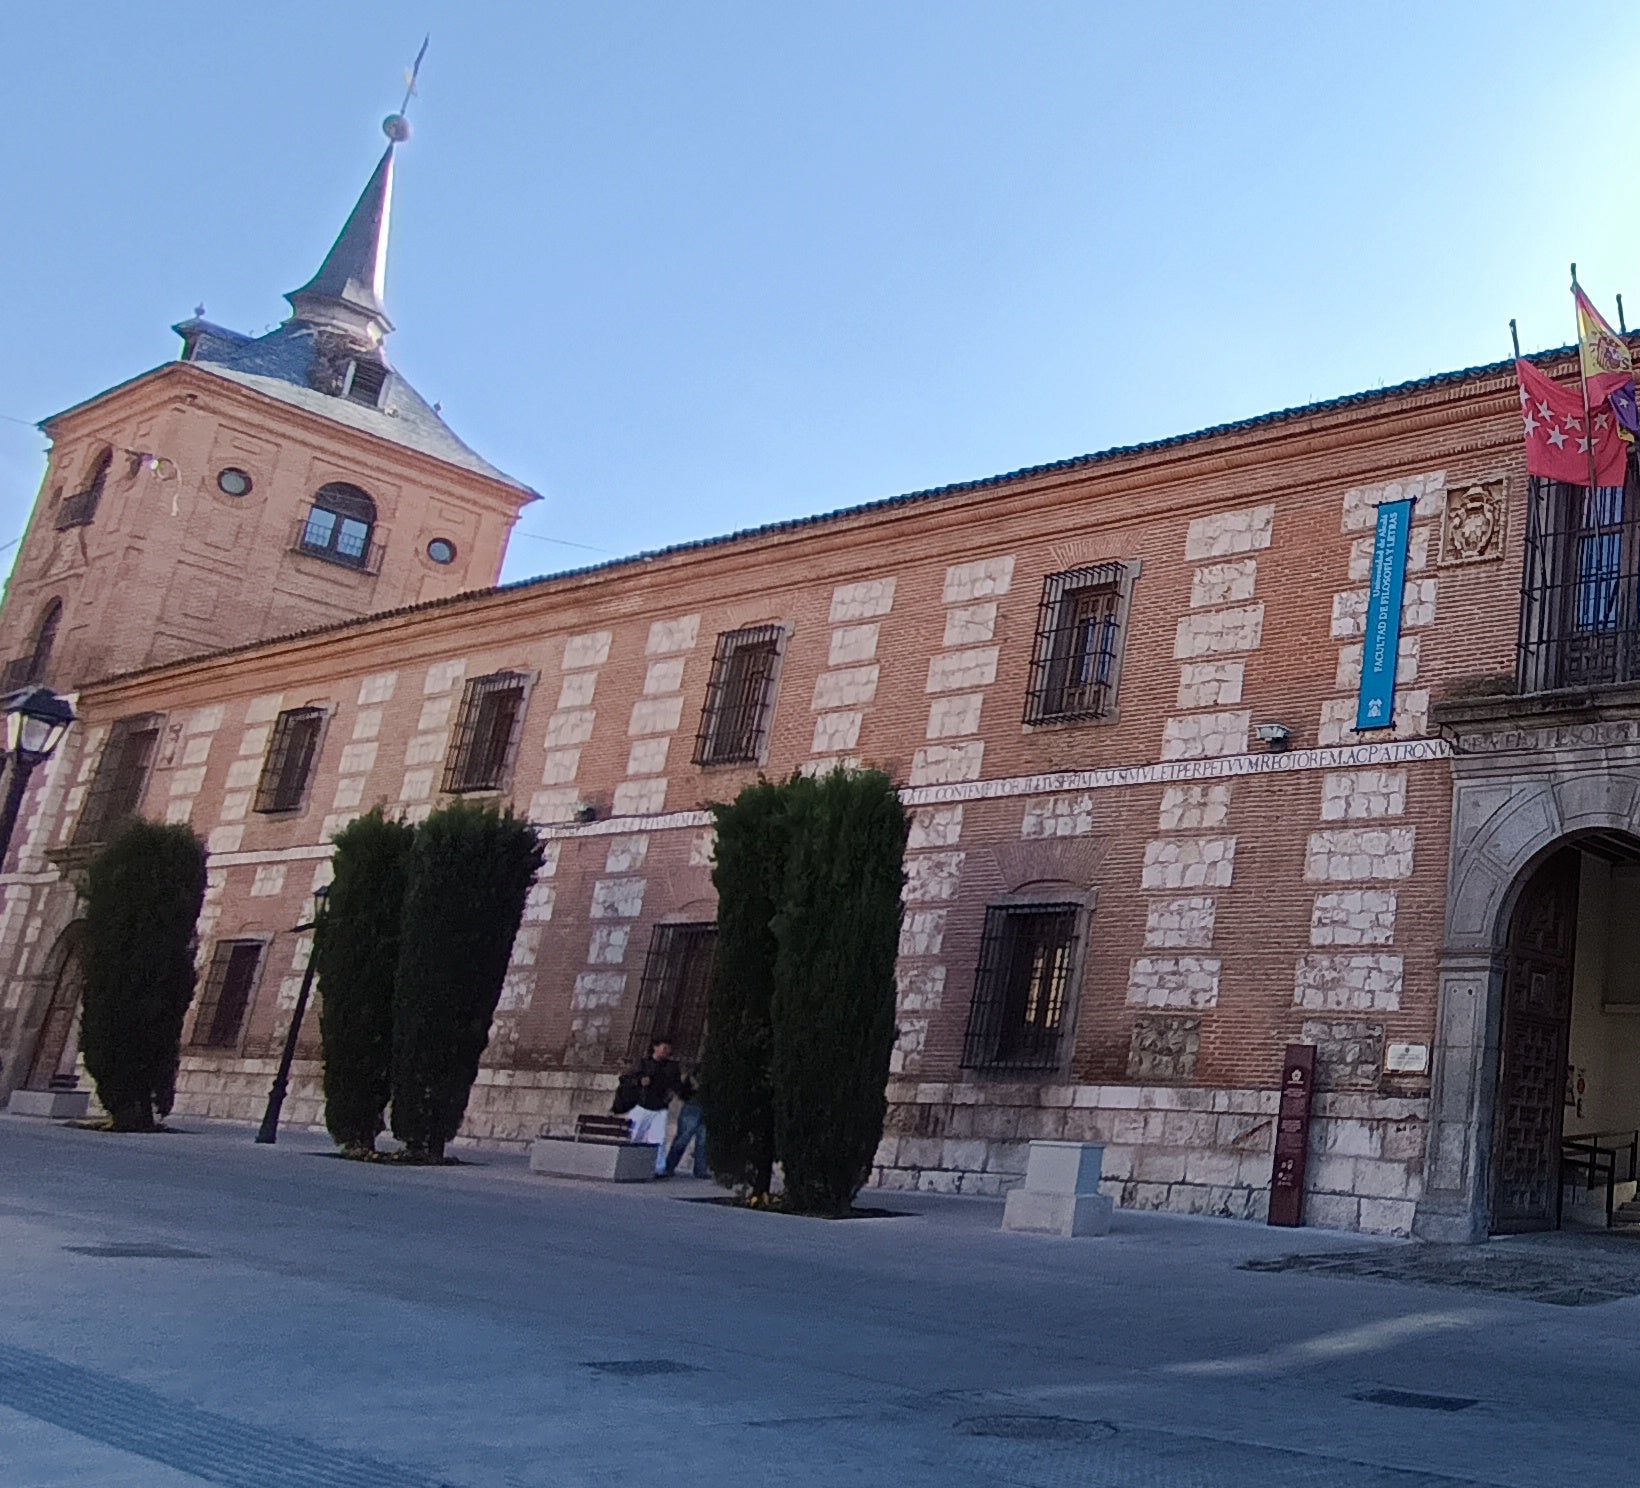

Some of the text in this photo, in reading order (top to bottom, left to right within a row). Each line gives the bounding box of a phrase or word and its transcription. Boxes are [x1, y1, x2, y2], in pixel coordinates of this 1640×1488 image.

[1377, 539, 1386, 549] de
[1386, 512, 1398, 548] LETRAS
[1372, 550, 1385, 597] Universidad
[1378, 605, 1389, 620] DE
[1374, 621, 1387, 673] FACULTAD
